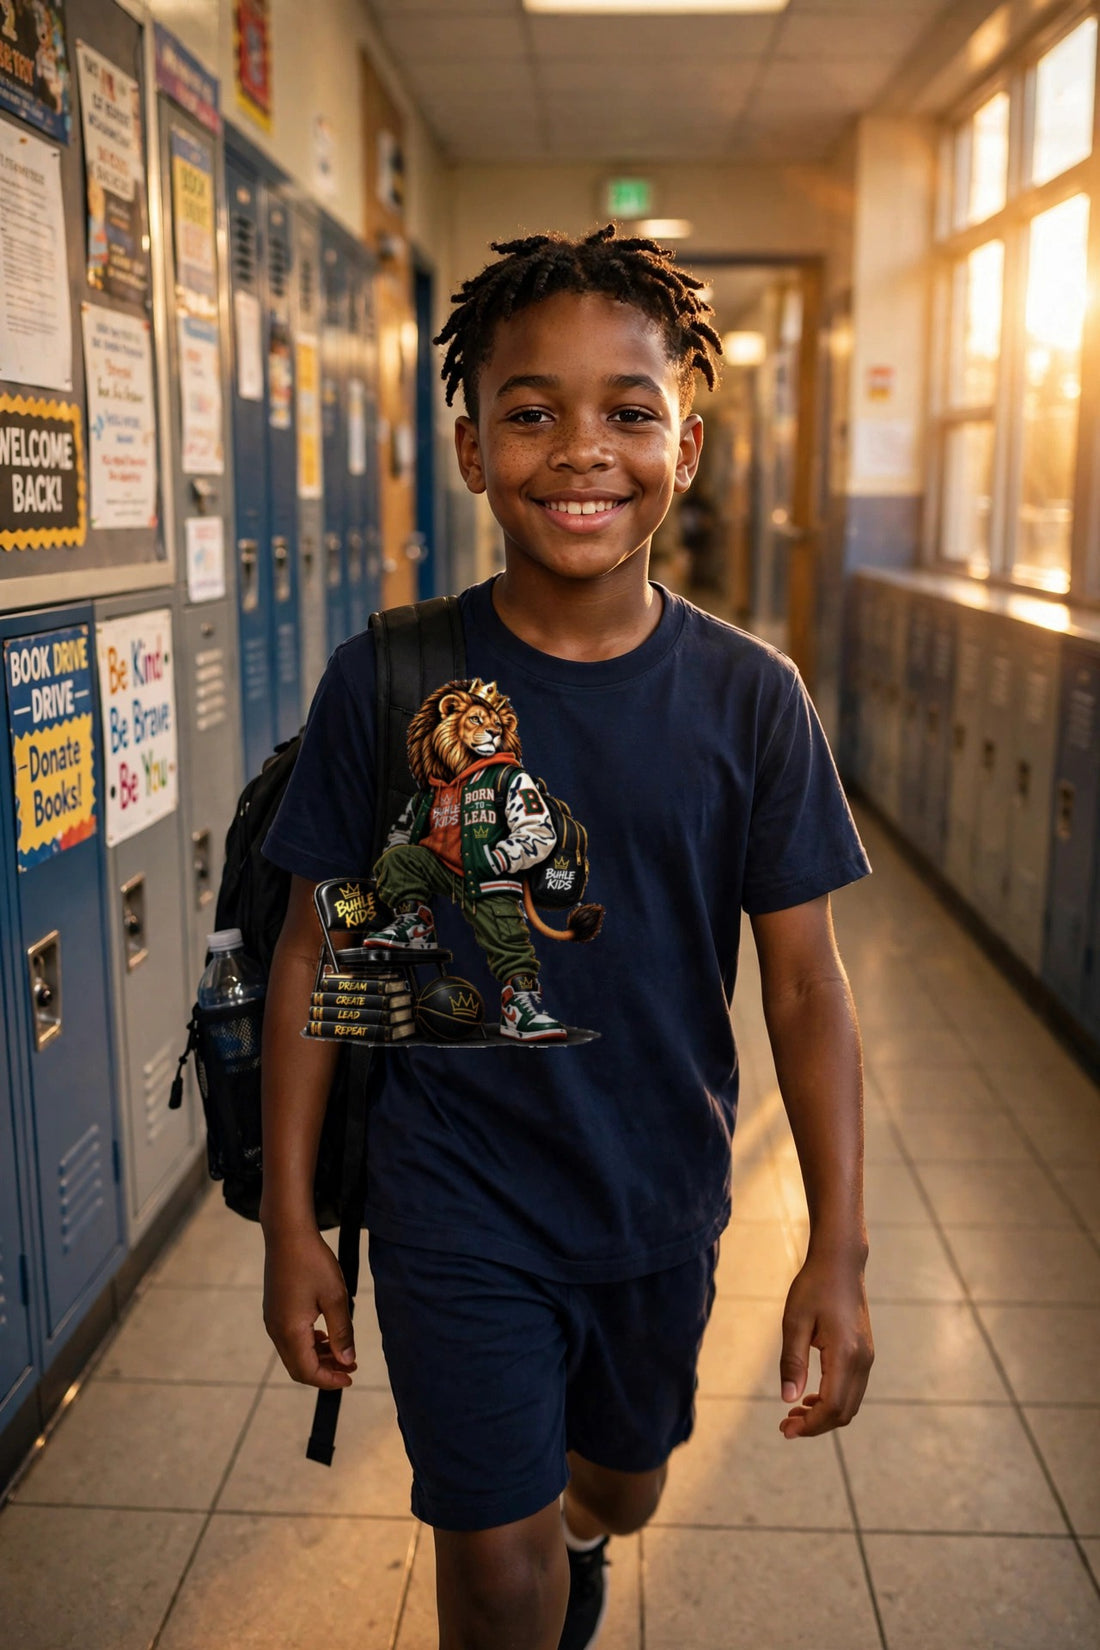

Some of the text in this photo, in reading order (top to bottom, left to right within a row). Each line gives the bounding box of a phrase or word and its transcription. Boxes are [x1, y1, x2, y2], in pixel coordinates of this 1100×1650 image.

[0, 426, 74, 471] WELCOME
[11, 473, 63, 514] BACK!
[10, 637, 88, 687] BOOK DRIVE
[107, 635, 164, 695] Be Kind
[32, 679, 75, 724] DRIVE
[110, 699, 170, 754] Be Brave
[29, 736, 81, 783] Donate
[119, 750, 168, 810] Be You
[34, 769, 82, 828] Books!
[464, 788, 495, 804] BORN
[475, 801, 485, 809] TO
[516, 788, 545, 816] B
[434, 814, 459, 829] KIDS
[464, 810, 497, 826] LEAD
[545, 868, 576, 881] BUHLE
[547, 879, 573, 891] KIDS
[334, 892, 375, 918] BUHLE
[345, 905, 377, 928] KIDS
[338, 981, 368, 991] DREAM
[335, 995, 366, 1006] CREATE
[337, 1010, 361, 1020] LEAD
[334, 1025, 368, 1036] REPEAT
